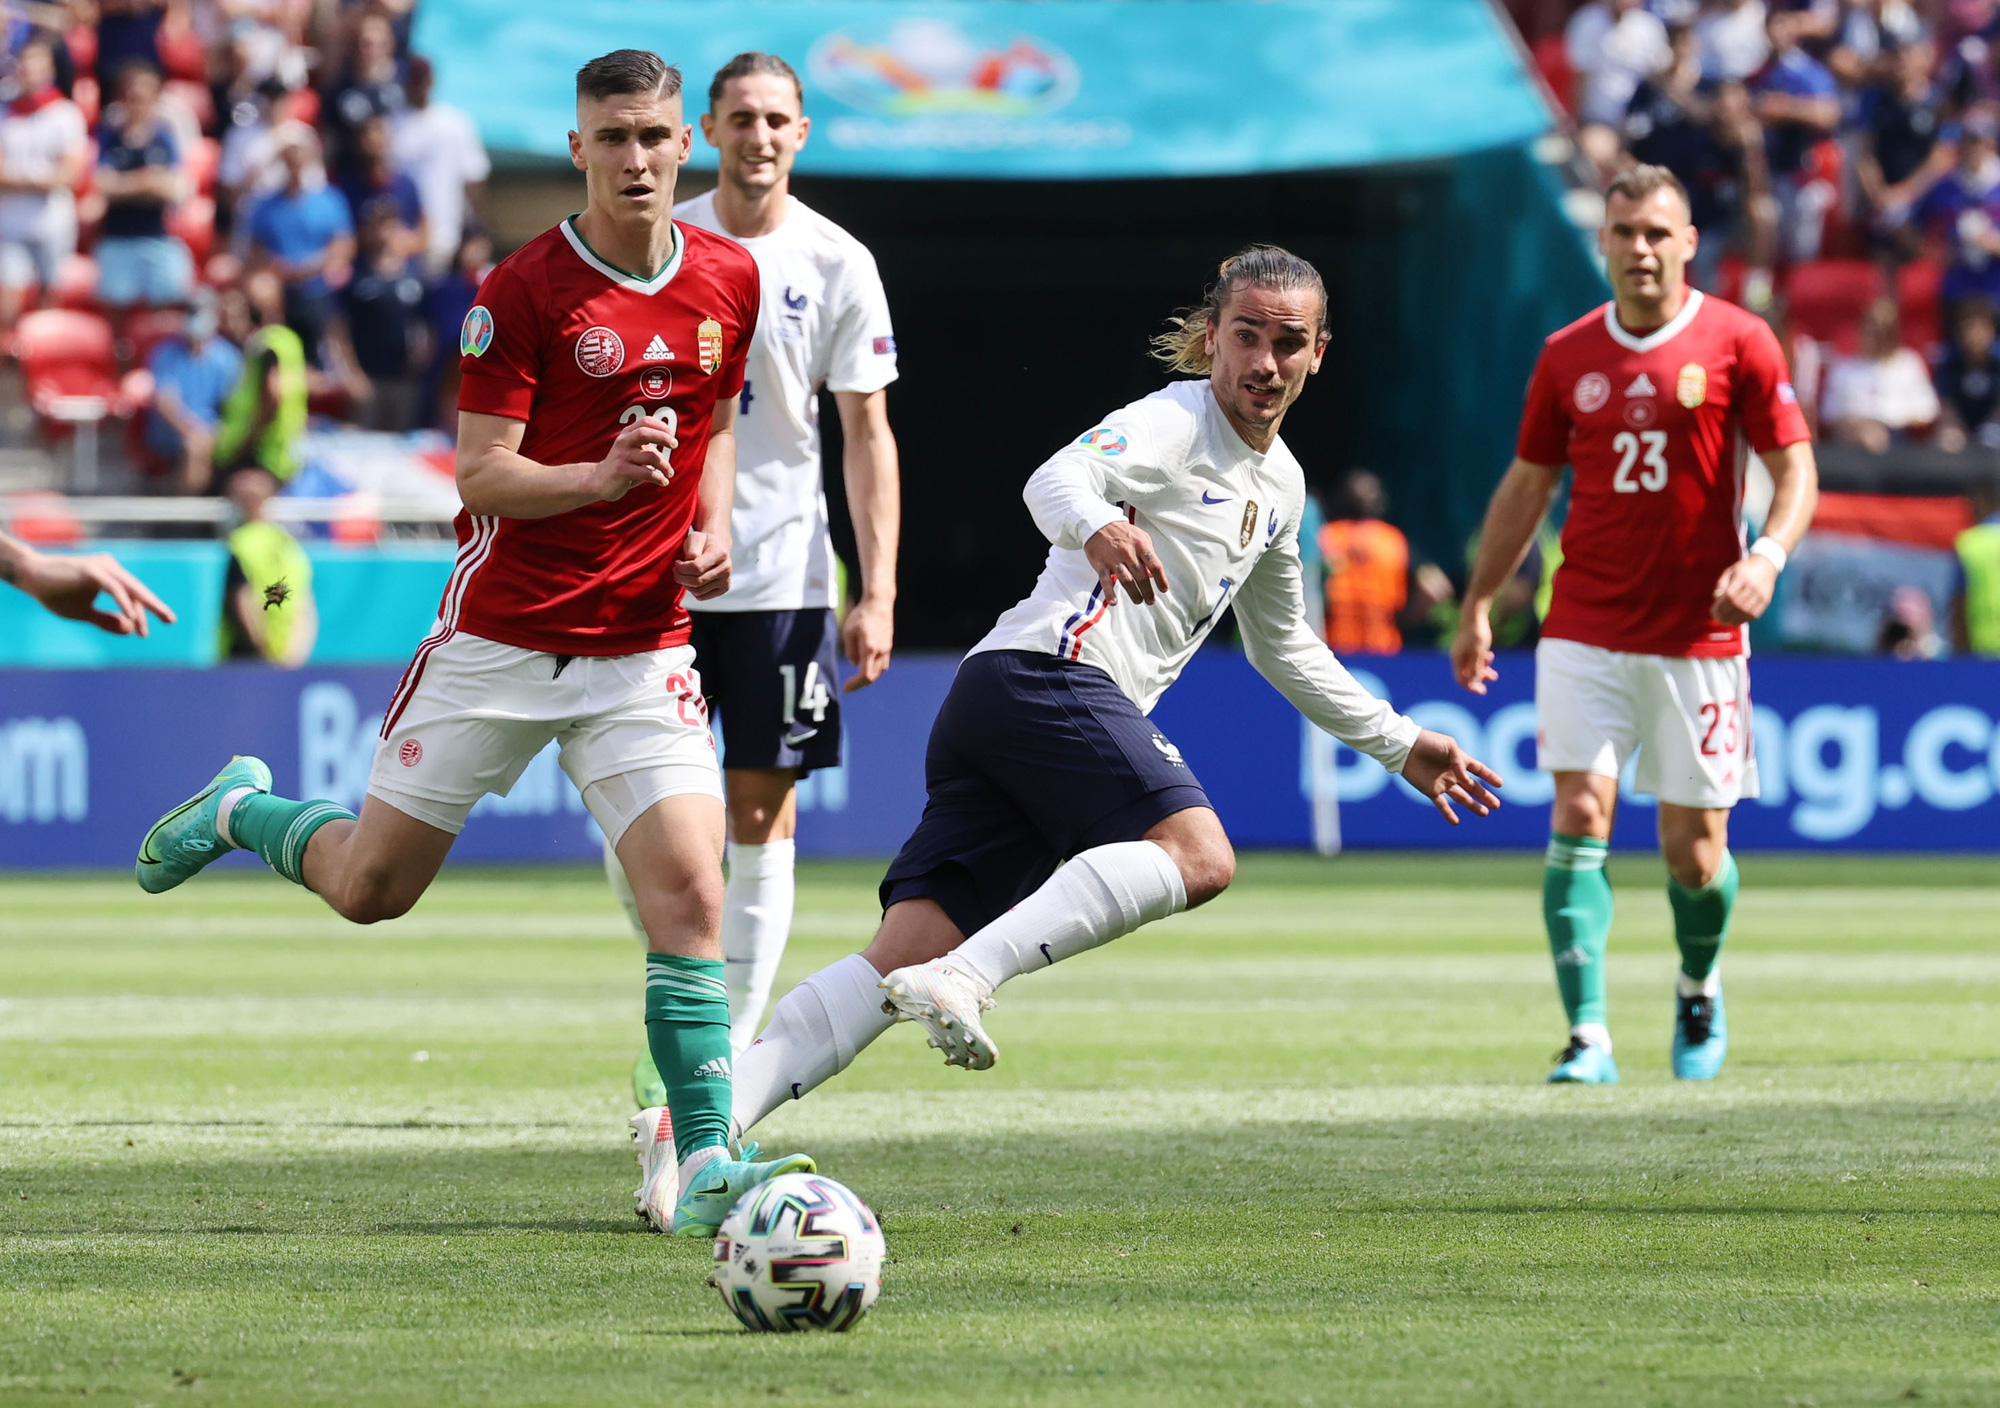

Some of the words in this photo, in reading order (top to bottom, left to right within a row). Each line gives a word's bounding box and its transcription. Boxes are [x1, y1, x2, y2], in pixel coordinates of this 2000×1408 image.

[642, 351, 676, 361] adidas
[1612, 430, 1668, 493] 23
[666, 668, 701, 727] 2
[779, 661, 829, 722] 14
[1700, 699, 1739, 755] 23
[693, 1069, 732, 1082] adida
